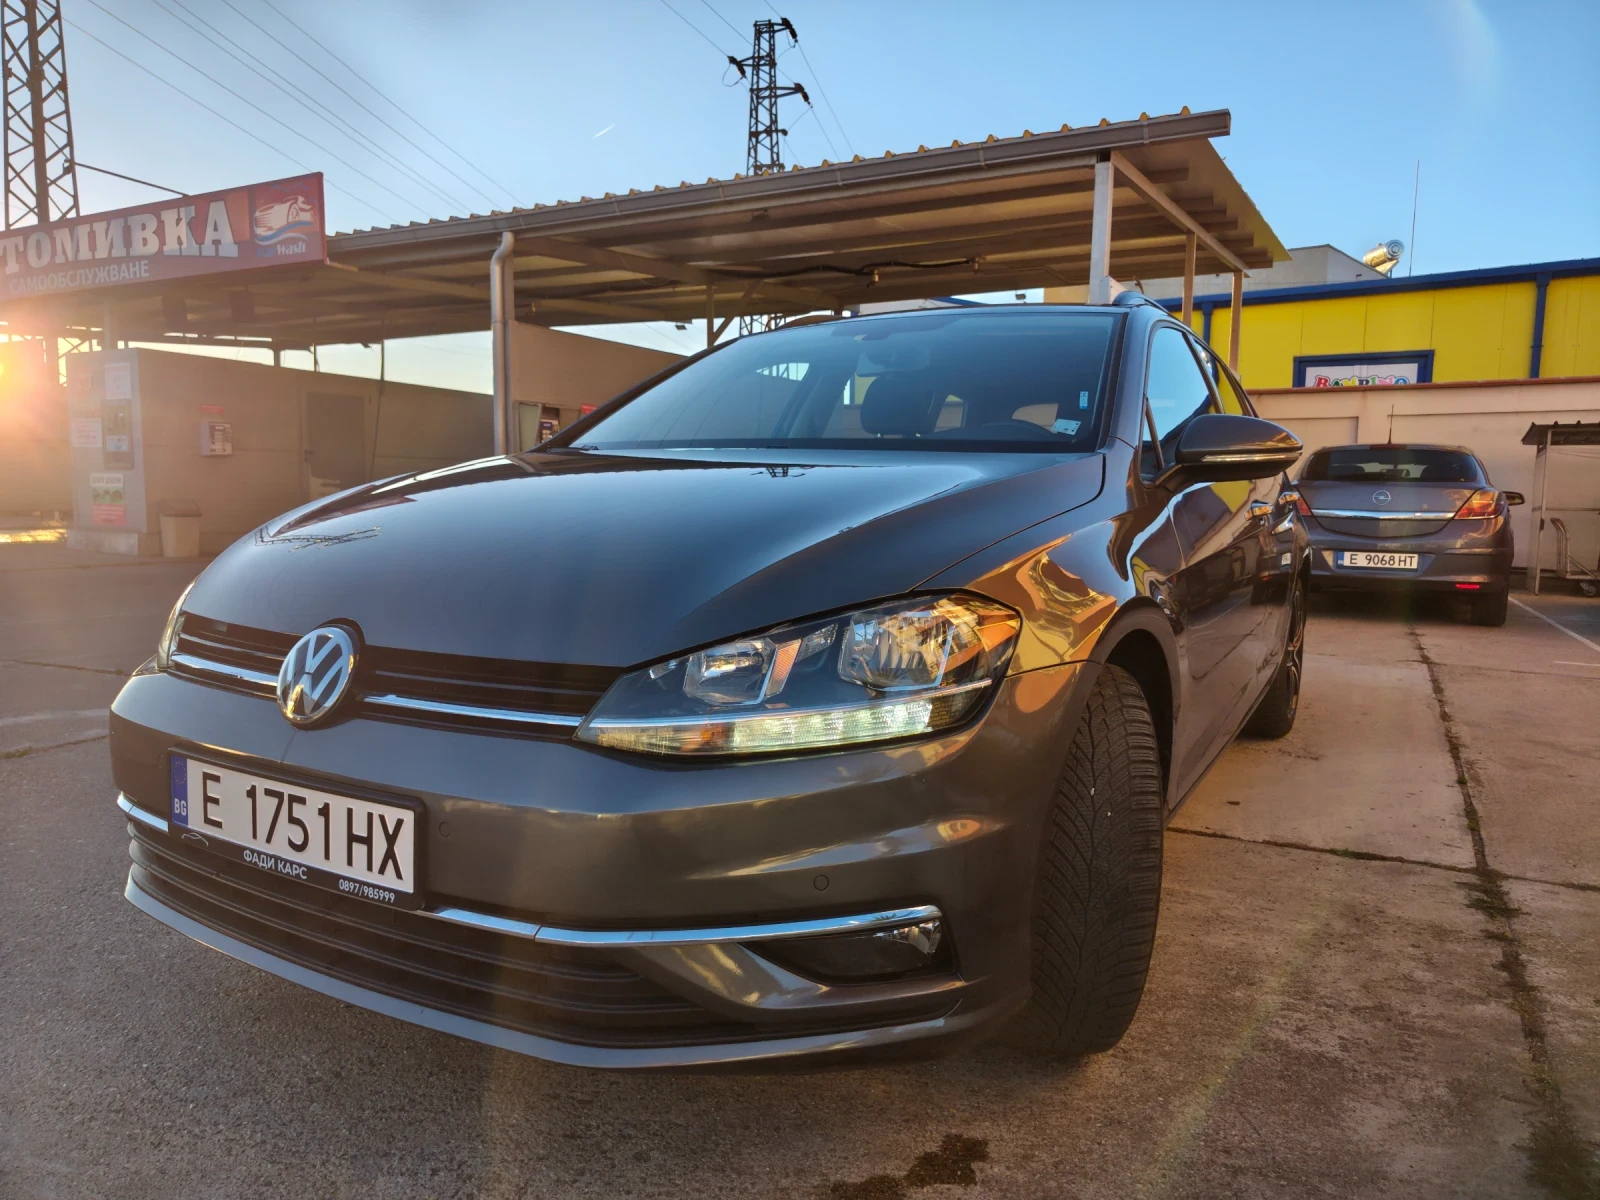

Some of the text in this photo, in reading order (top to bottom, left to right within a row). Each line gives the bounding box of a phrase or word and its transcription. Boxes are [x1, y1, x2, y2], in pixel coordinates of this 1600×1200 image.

[0, 200, 239, 275] ТОМИВКА
[9, 259, 150, 294] САМООБСЛУЖВАНЕ
[174, 797, 187, 816] BG
[243, 849, 308, 880] ФАДИ КАРС
[338, 878, 395, 903] 0897/985999
